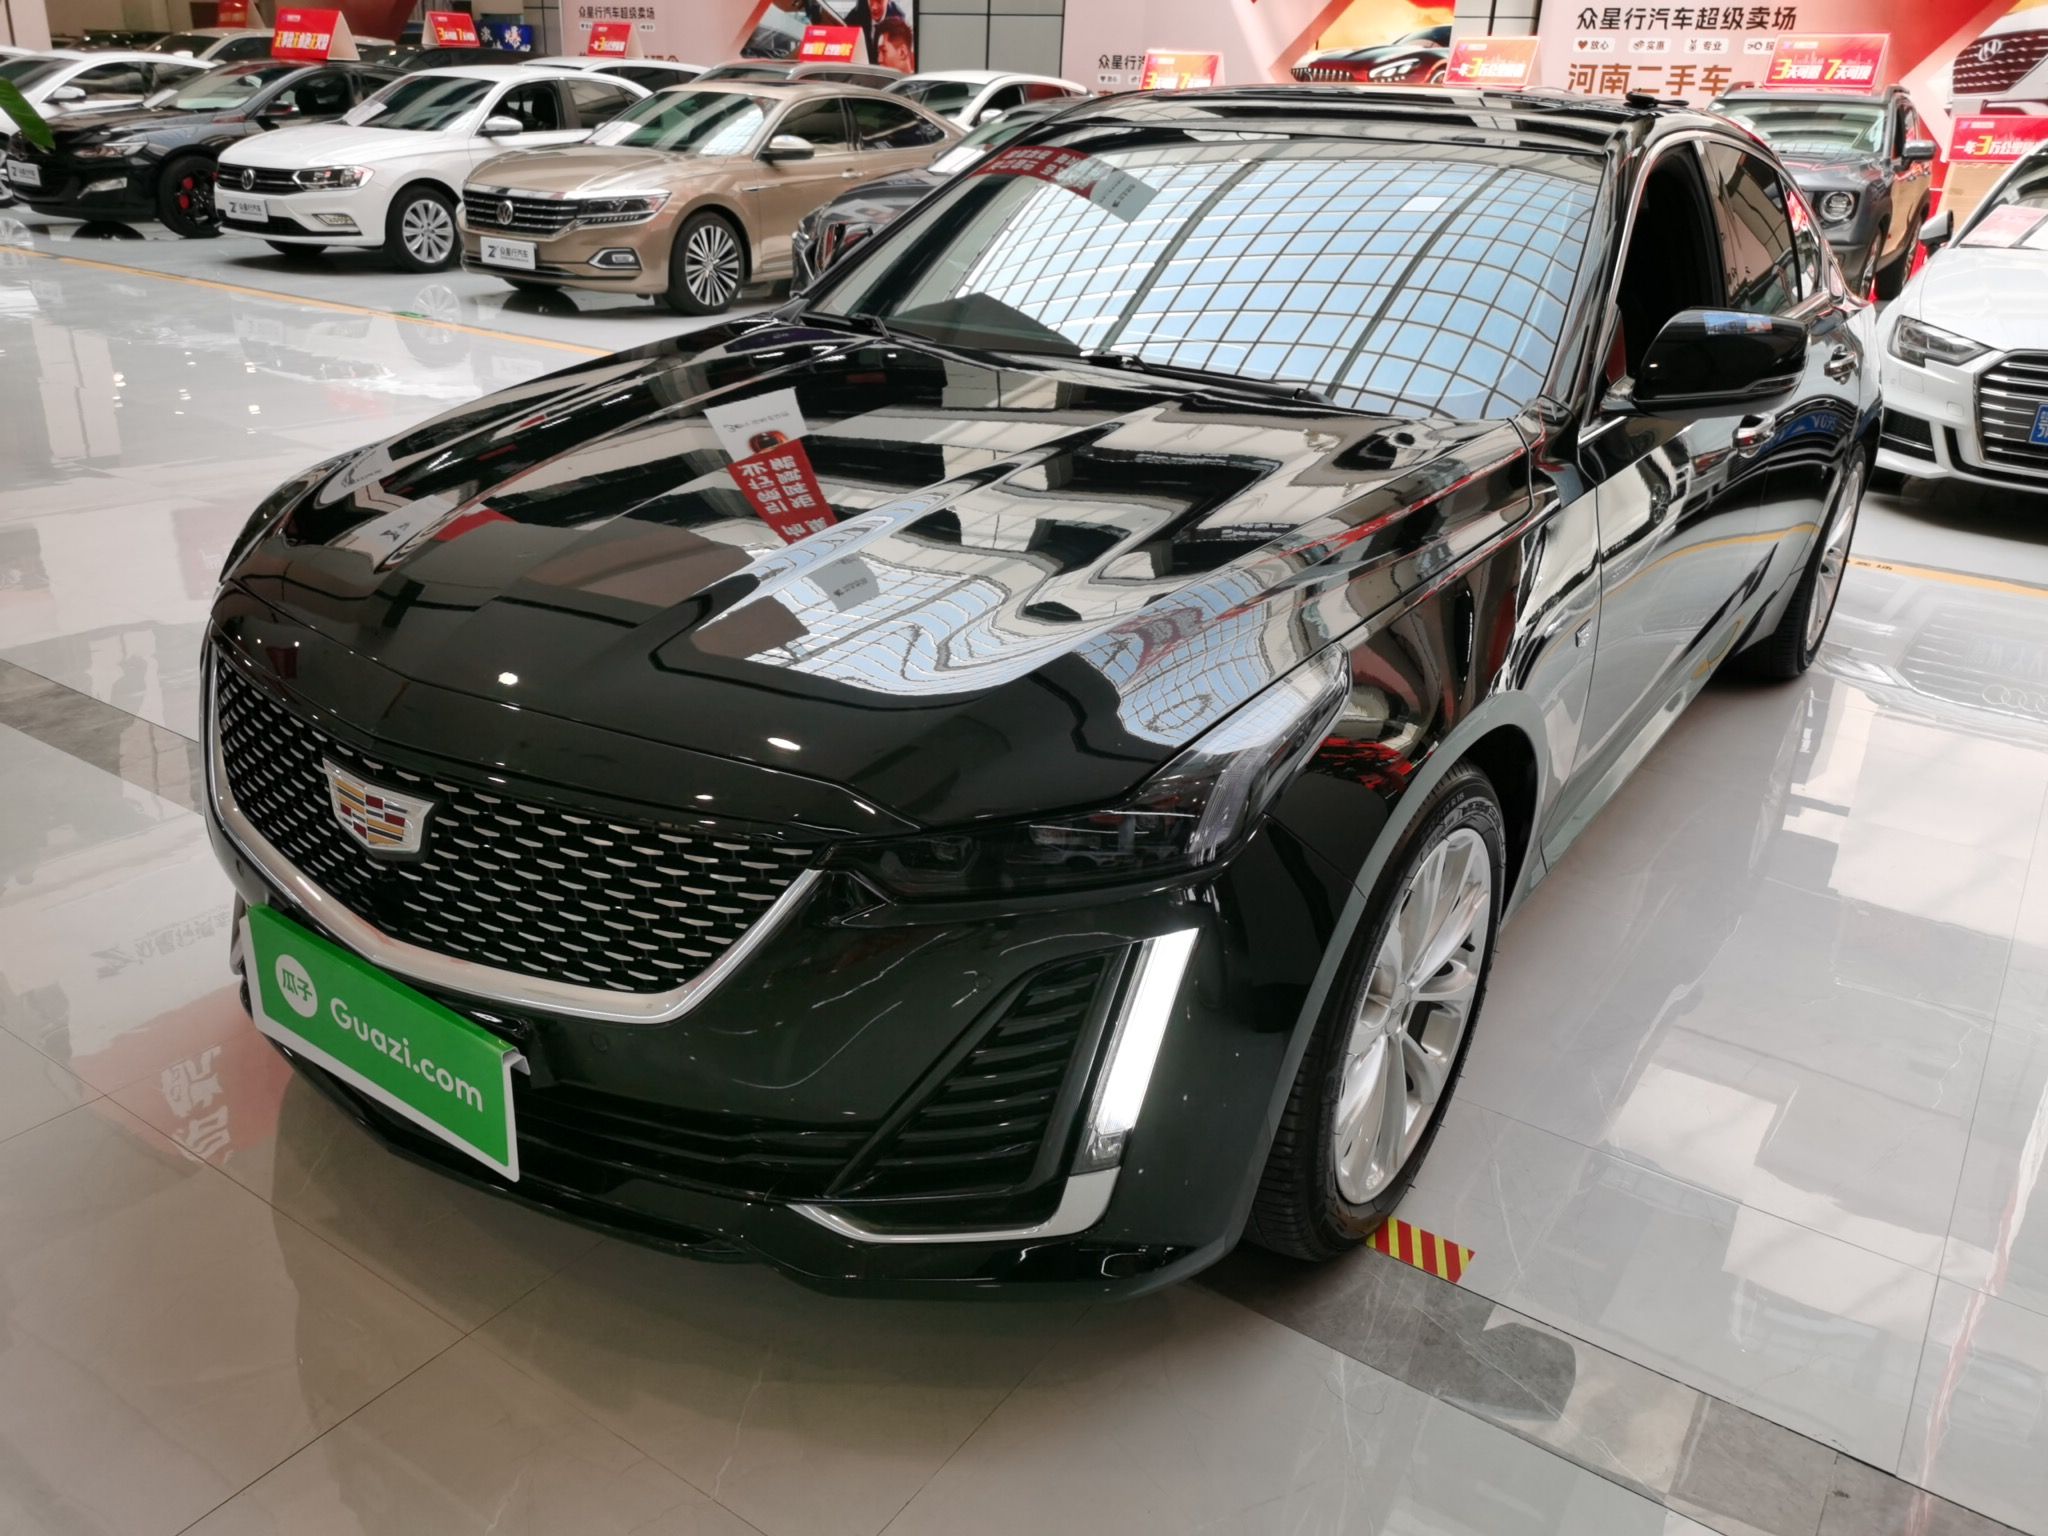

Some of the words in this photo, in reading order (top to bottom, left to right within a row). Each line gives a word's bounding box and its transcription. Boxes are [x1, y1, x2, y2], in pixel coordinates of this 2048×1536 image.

[1576, 7, 1797, 31] 众星行汽车超级卖场
[1703, 41, 1722, 51] 专业
[1567, 63, 1732, 96] 河南二手车
[282, 967, 314, 1002] 瓜子
[330, 997, 483, 1112] Guazi.com
